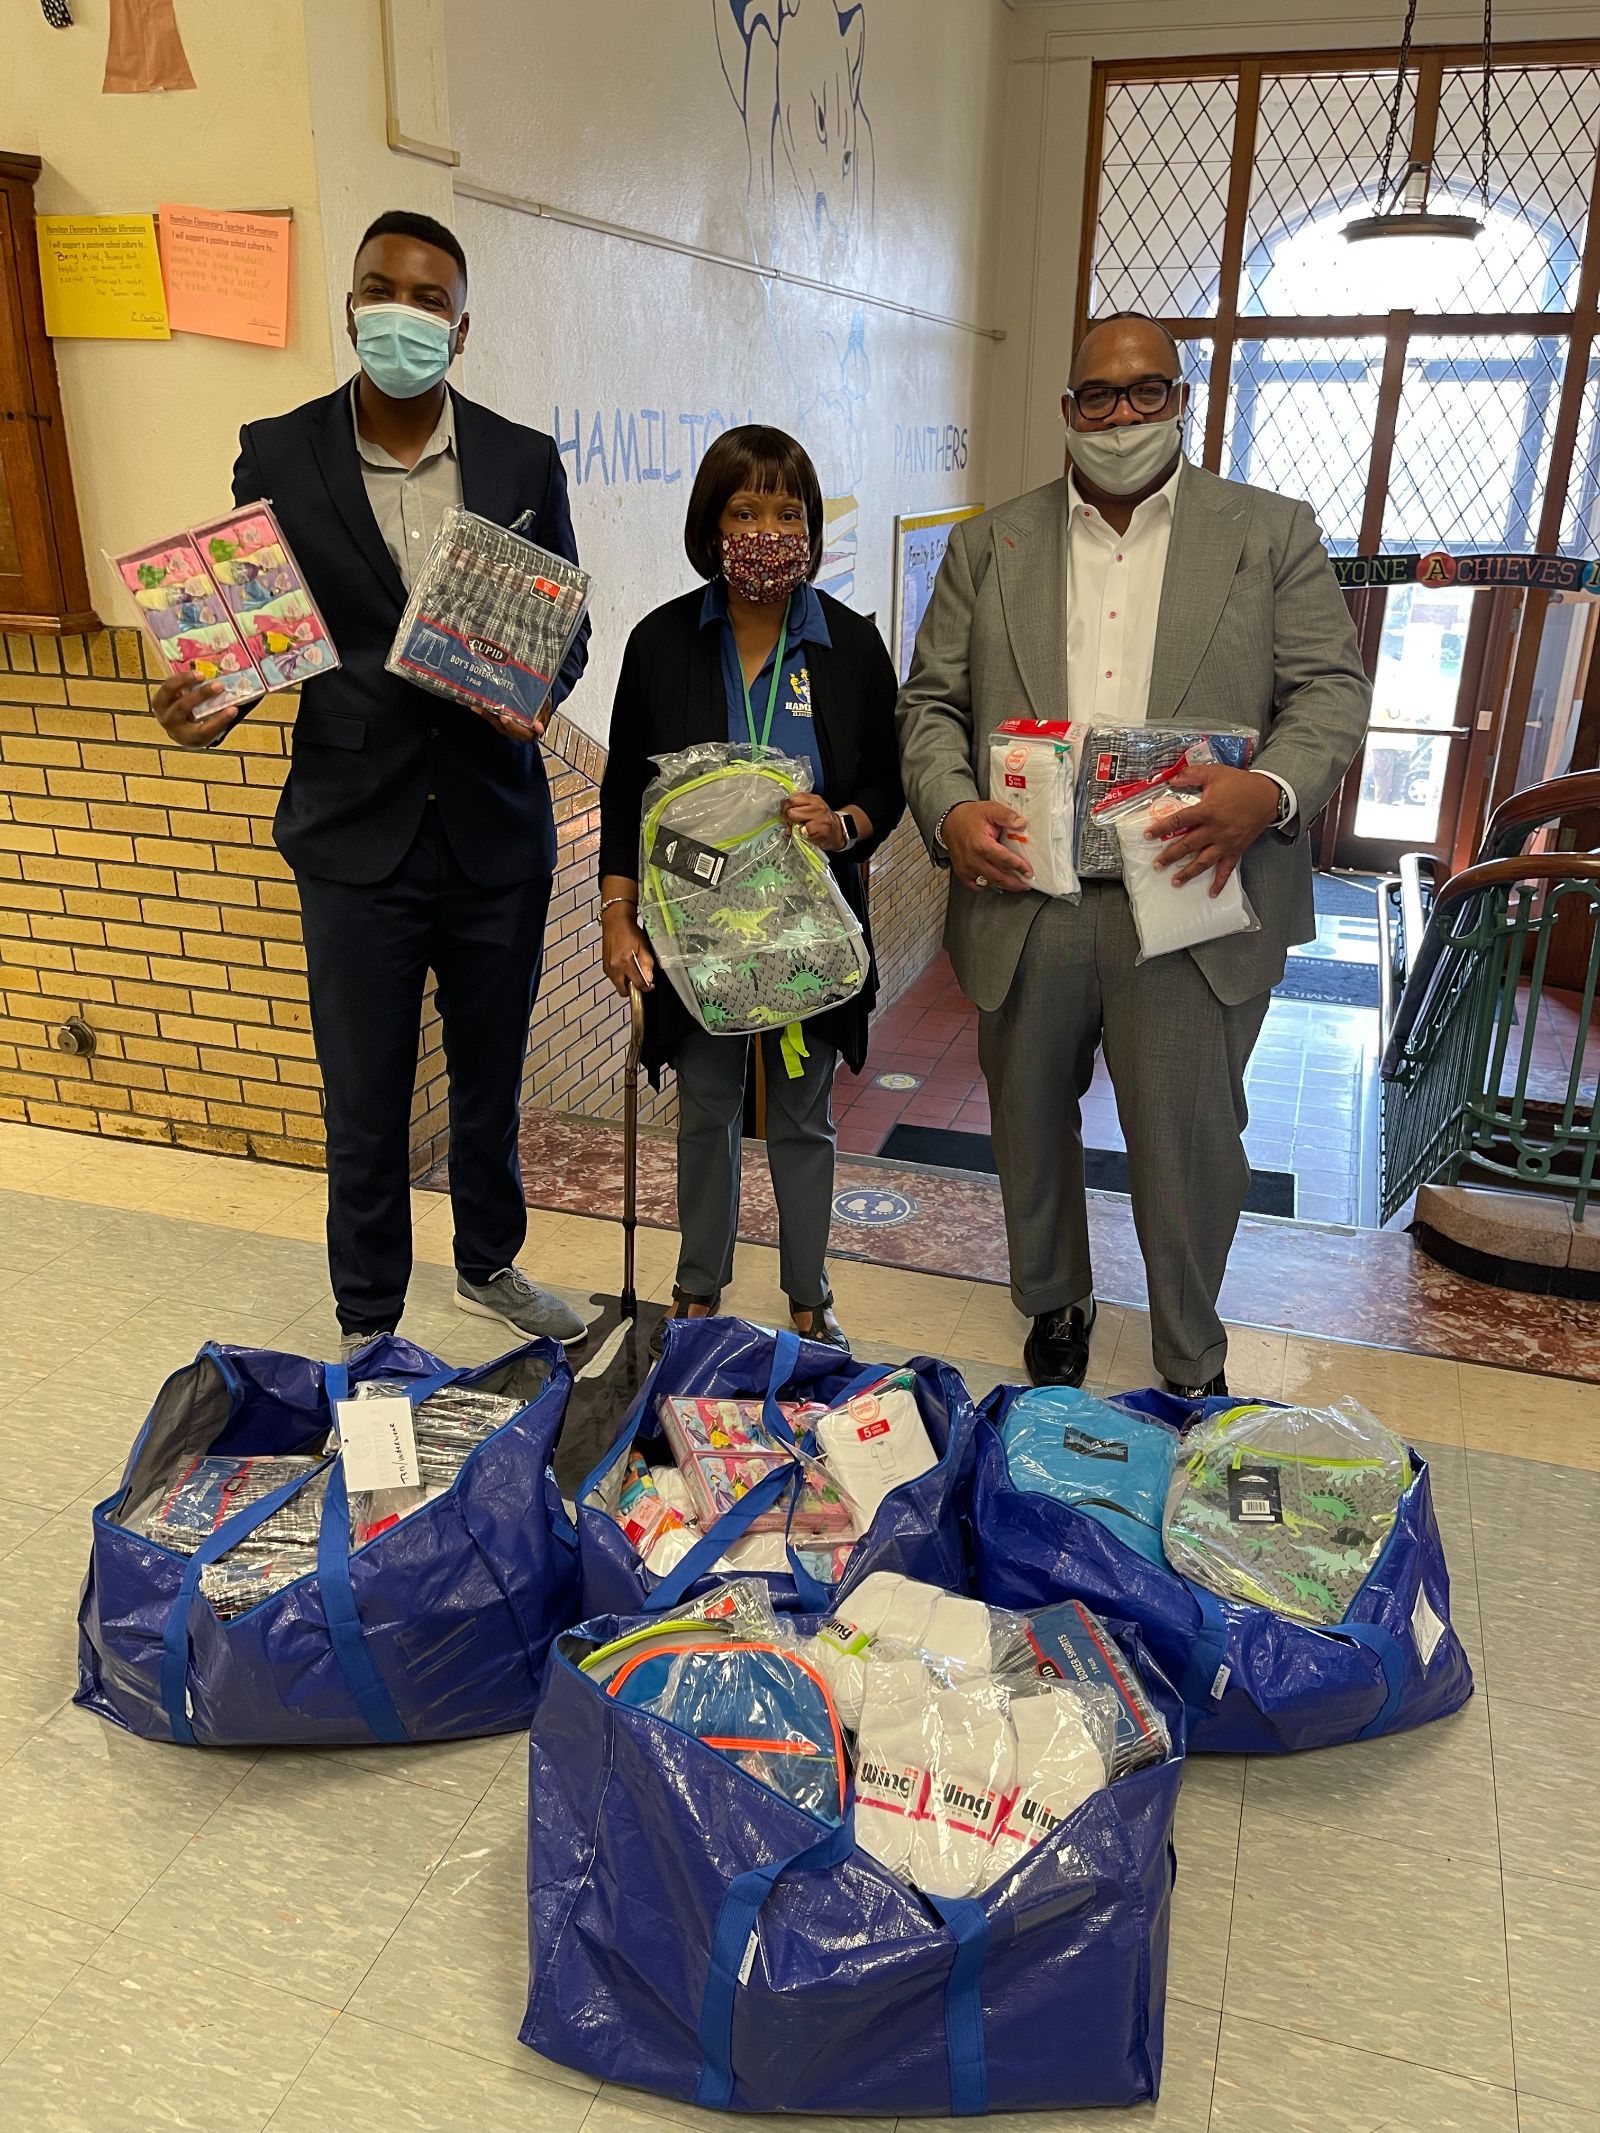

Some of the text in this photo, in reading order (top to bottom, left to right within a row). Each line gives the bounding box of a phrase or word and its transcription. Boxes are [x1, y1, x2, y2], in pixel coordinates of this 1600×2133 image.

[69, 224, 98, 234] Elementary
[98, 224, 117, 233] Teacher
[194, 216, 223, 230] Elementary
[225, 221, 246, 232] Teacher
[246, 224, 279, 237] Affirmations
[52, 241, 61, 249] will
[61, 241, 80, 249] support
[86, 241, 104, 249] positive
[105, 241, 120, 249] school
[121, 241, 137, 249] culture
[175, 231, 185, 240] will
[185, 233, 205, 243] support
[209, 238, 230, 247] positive
[230, 240, 247, 249] school
[247, 241, 265, 251] culture
[894, 424, 968, 474] PANTHERS
[1423, 557, 1577, 584] ACHIEVES
[470, 639, 503, 660] CUPID
[450, 654, 470, 670] BOY'S
[469, 663, 491, 680] BOXER
[469, 677, 482, 687] PAIR
[1008, 776, 1014, 786] 5
[863, 1427, 872, 1438] 5
[1057, 1634, 1089, 1682] BOXER SHORTS
[860, 1762, 915, 1799] wing
